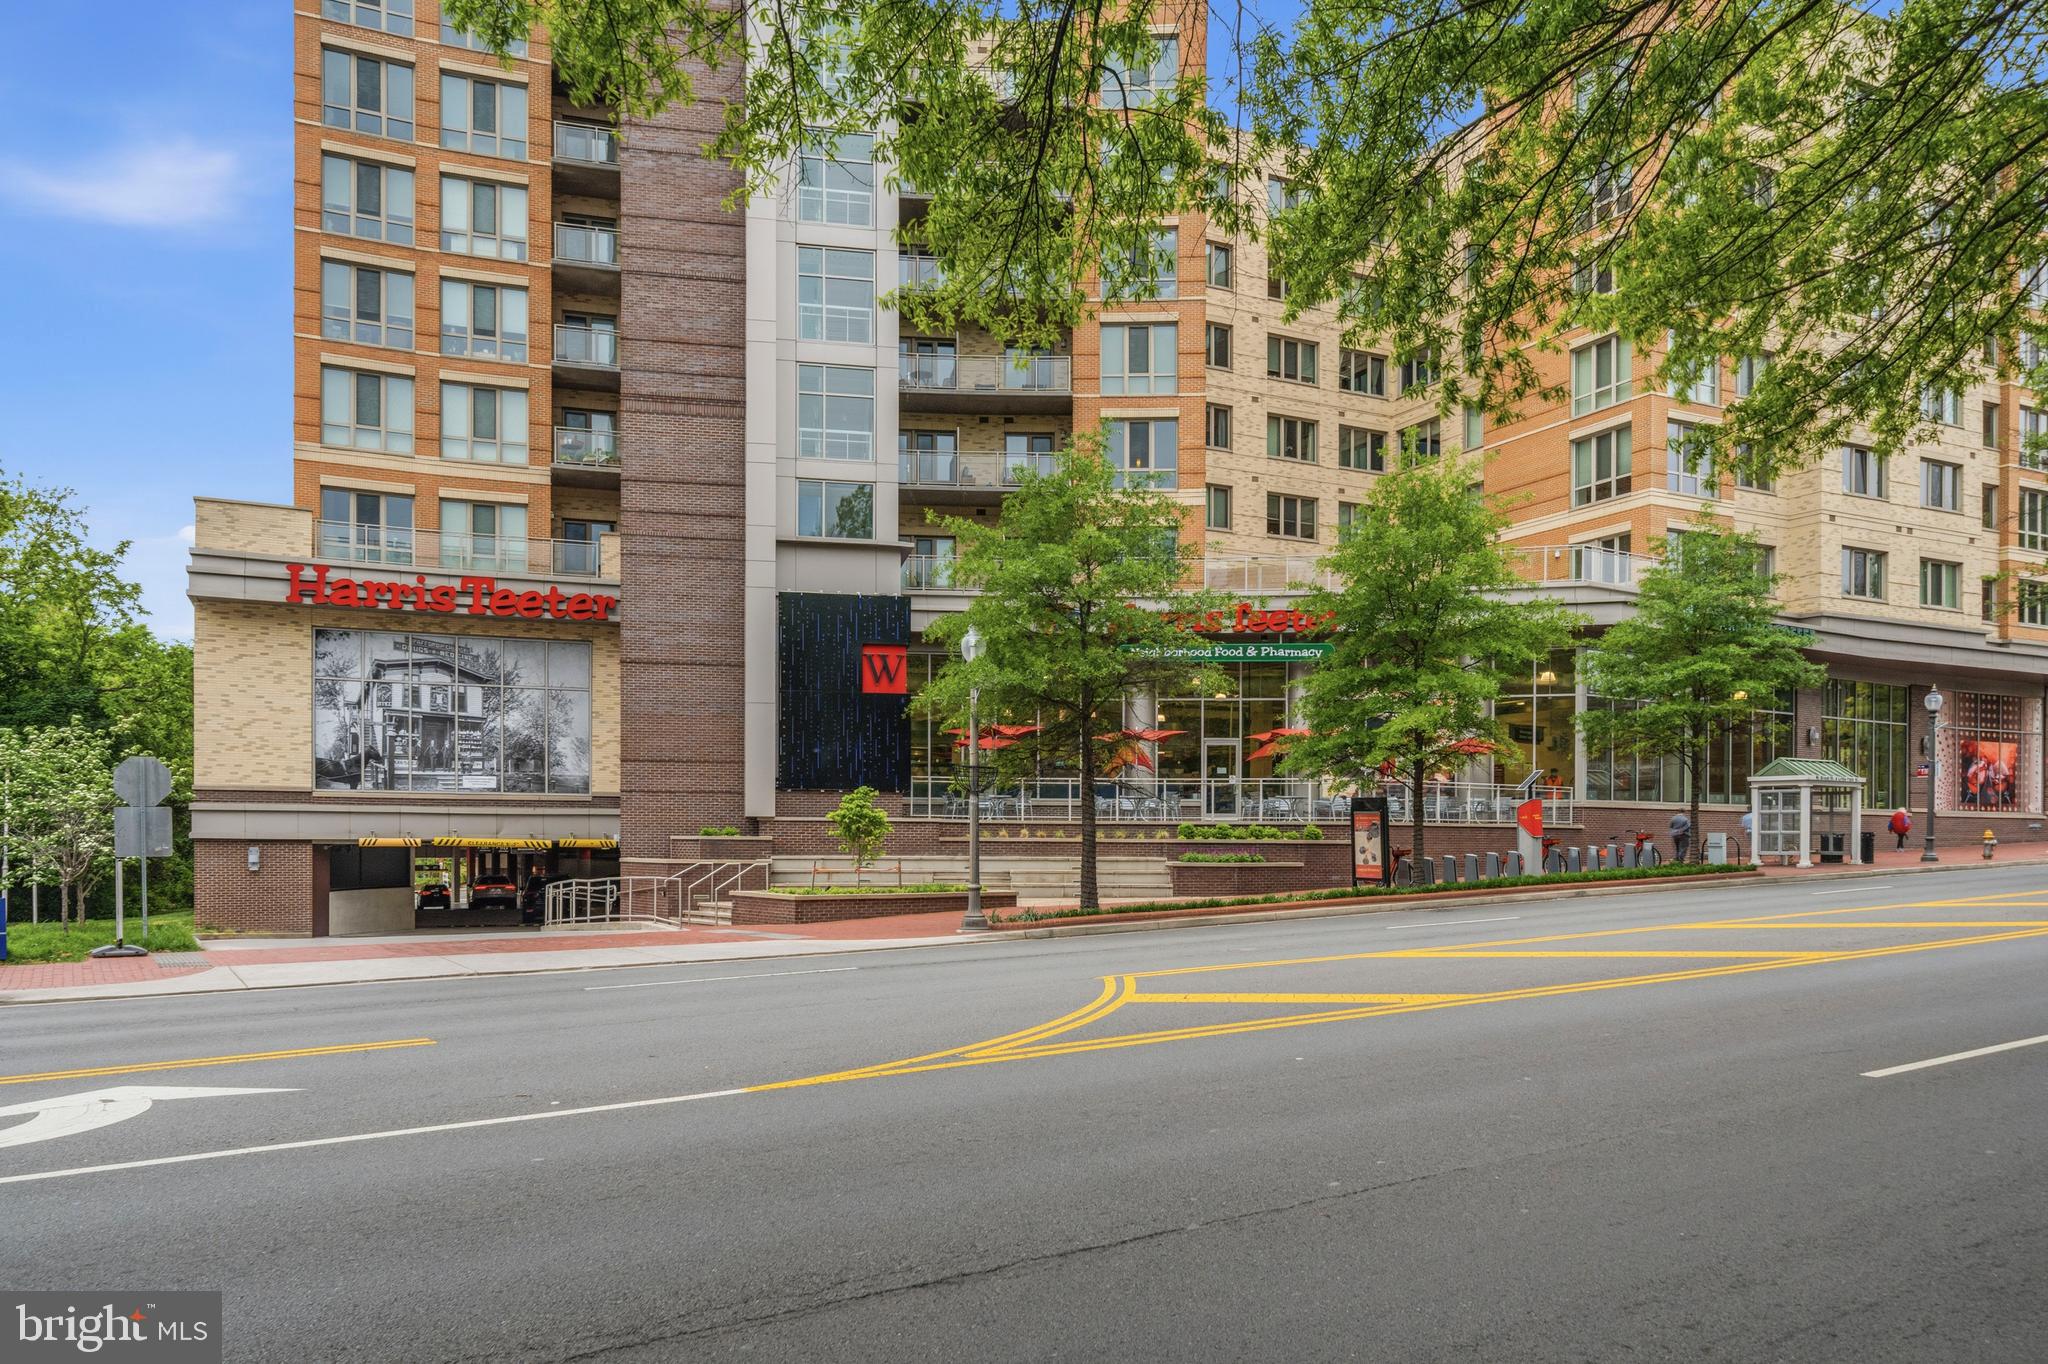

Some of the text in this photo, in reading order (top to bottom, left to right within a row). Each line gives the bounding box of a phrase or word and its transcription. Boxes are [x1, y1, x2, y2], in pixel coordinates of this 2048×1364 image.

[286, 564, 616, 621] Harris Teeter
[1214, 646, 1244, 657] Food
[1247, 645, 1259, 657] &
[1260, 646, 1323, 659] Pharmacy
[863, 653, 905, 685] W
